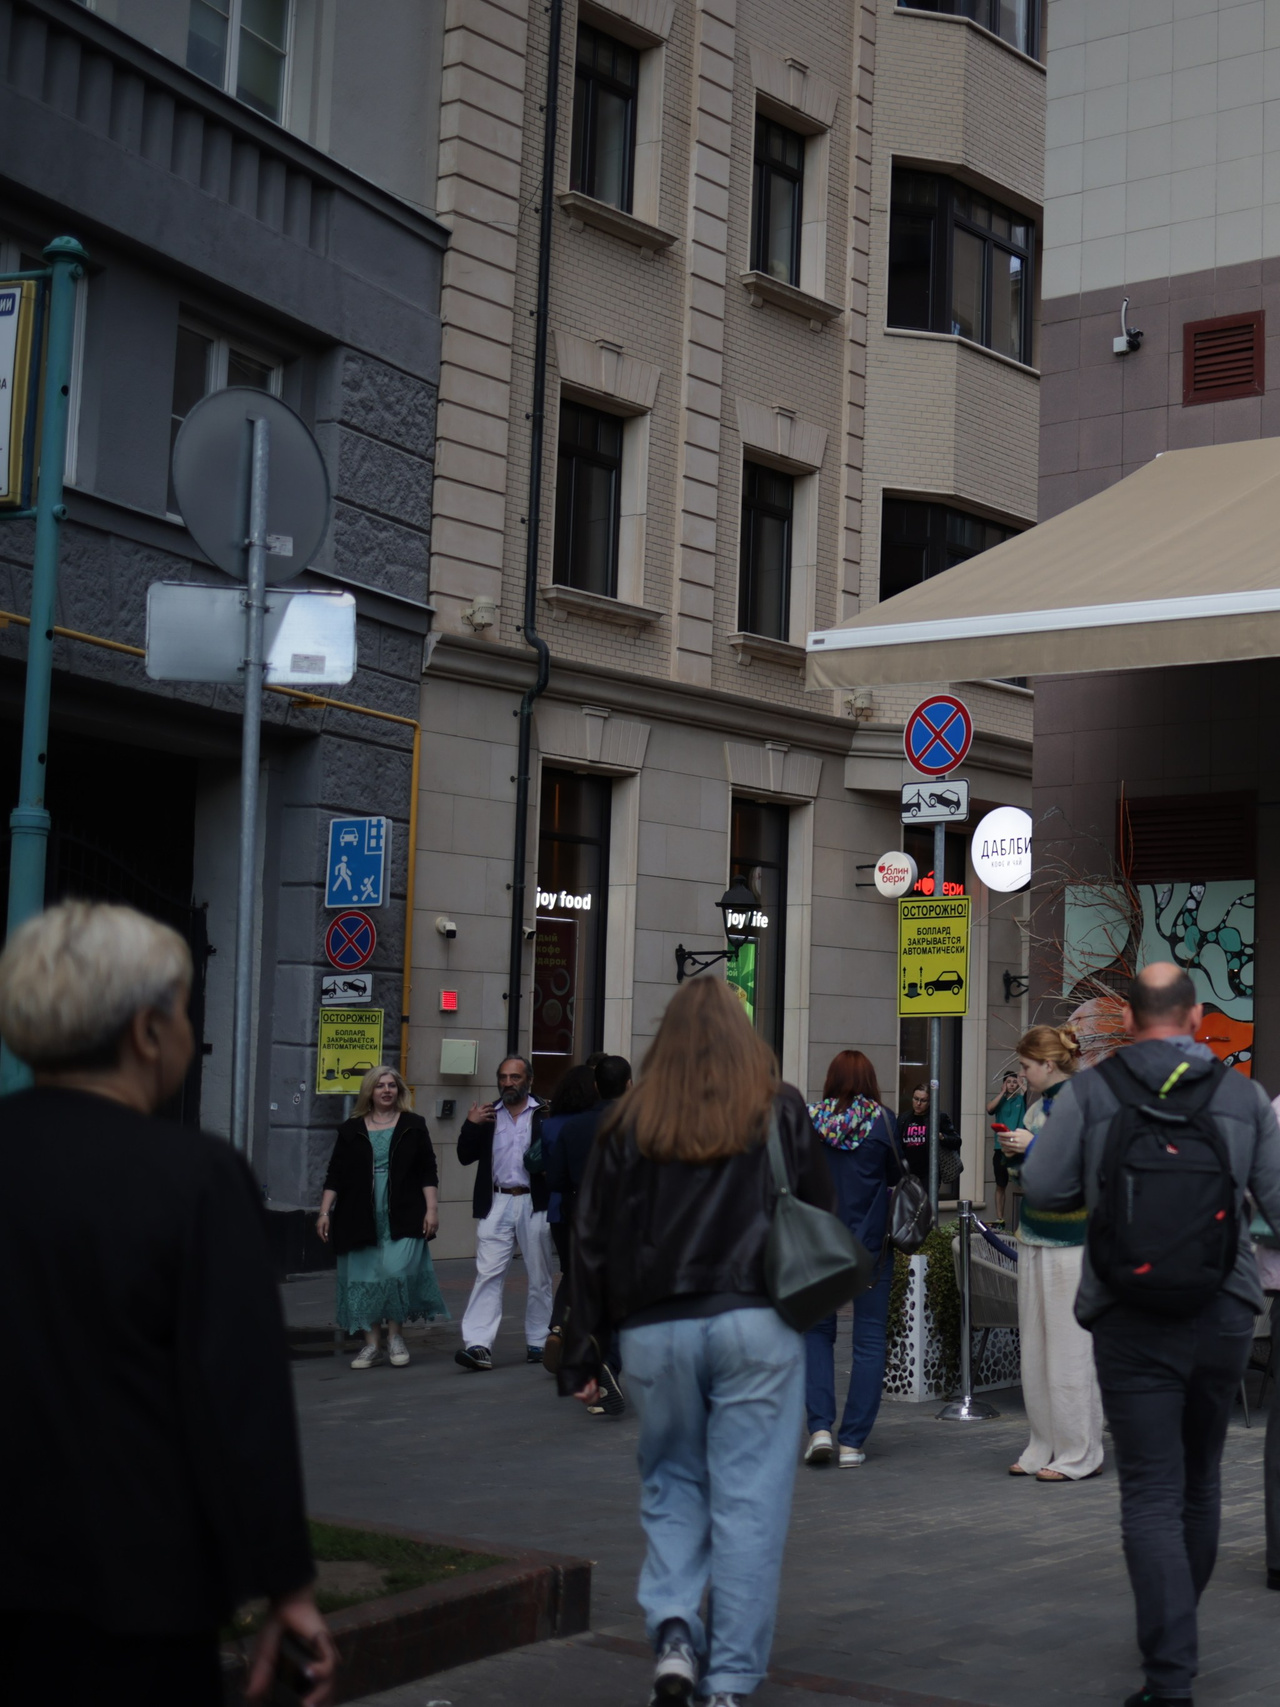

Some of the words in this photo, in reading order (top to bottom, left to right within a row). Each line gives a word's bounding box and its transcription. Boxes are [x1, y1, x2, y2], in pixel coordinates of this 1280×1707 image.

[981, 836, 1032, 859] ДАБЛБИ
[886, 864, 909, 875] блин
[882, 872, 905, 885] бери
[942, 881, 964, 896] ери
[560, 890, 592, 910] food
[902, 904, 967, 917] ОСТОРОЖНО!
[917, 926, 951, 935] БОЛЛАРД
[536, 933, 558, 942] дый
[907, 936, 961, 946] ЗАКРЫВАЕТСЯ
[903, 946, 965, 955] АВТОМАТИЧЕСКИ
[323, 1014, 380, 1022] ОСТОРОЖНО!
